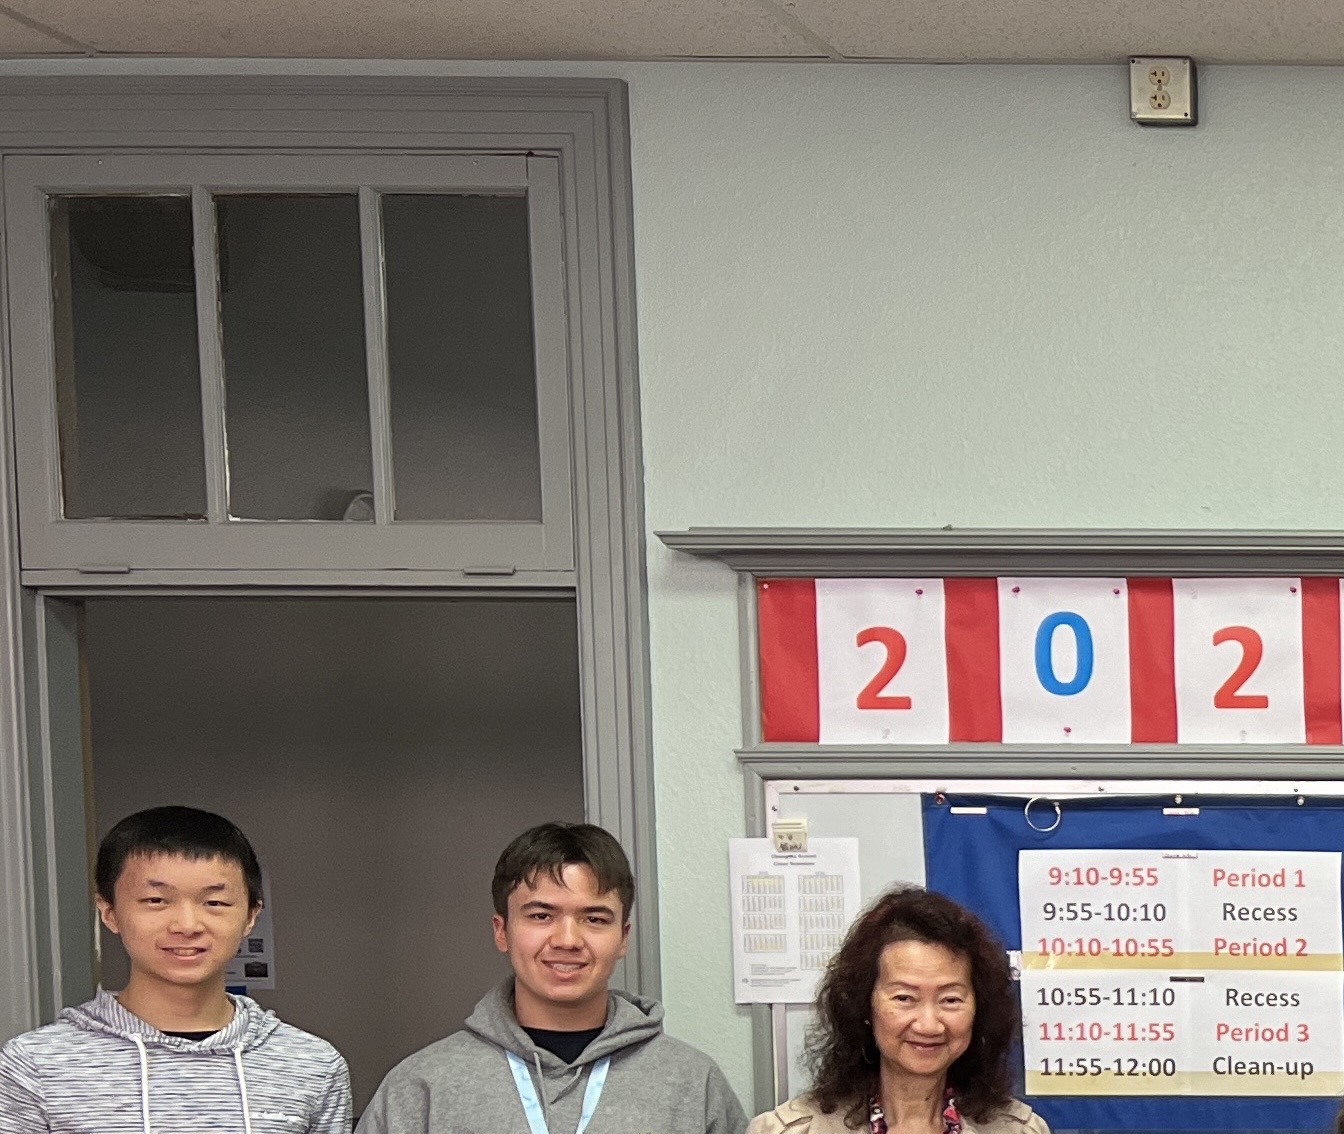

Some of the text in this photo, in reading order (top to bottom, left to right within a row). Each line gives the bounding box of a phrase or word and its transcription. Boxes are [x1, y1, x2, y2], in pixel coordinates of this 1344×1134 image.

[1048, 867, 1306, 888] 9:10-9:55 Period 1
[1043, 903, 1298, 922] 9:55-10:10 Recess
[1038, 938, 1308, 957] 10:10-10:55 Period 2
[1037, 988, 1300, 1007] 10:55-11:10 Recess
[1039, 1023, 1310, 1042] 11:10-11:55 Period 3
[1040, 1056, 1314, 1080] 11:55-12:00 Clean-up
